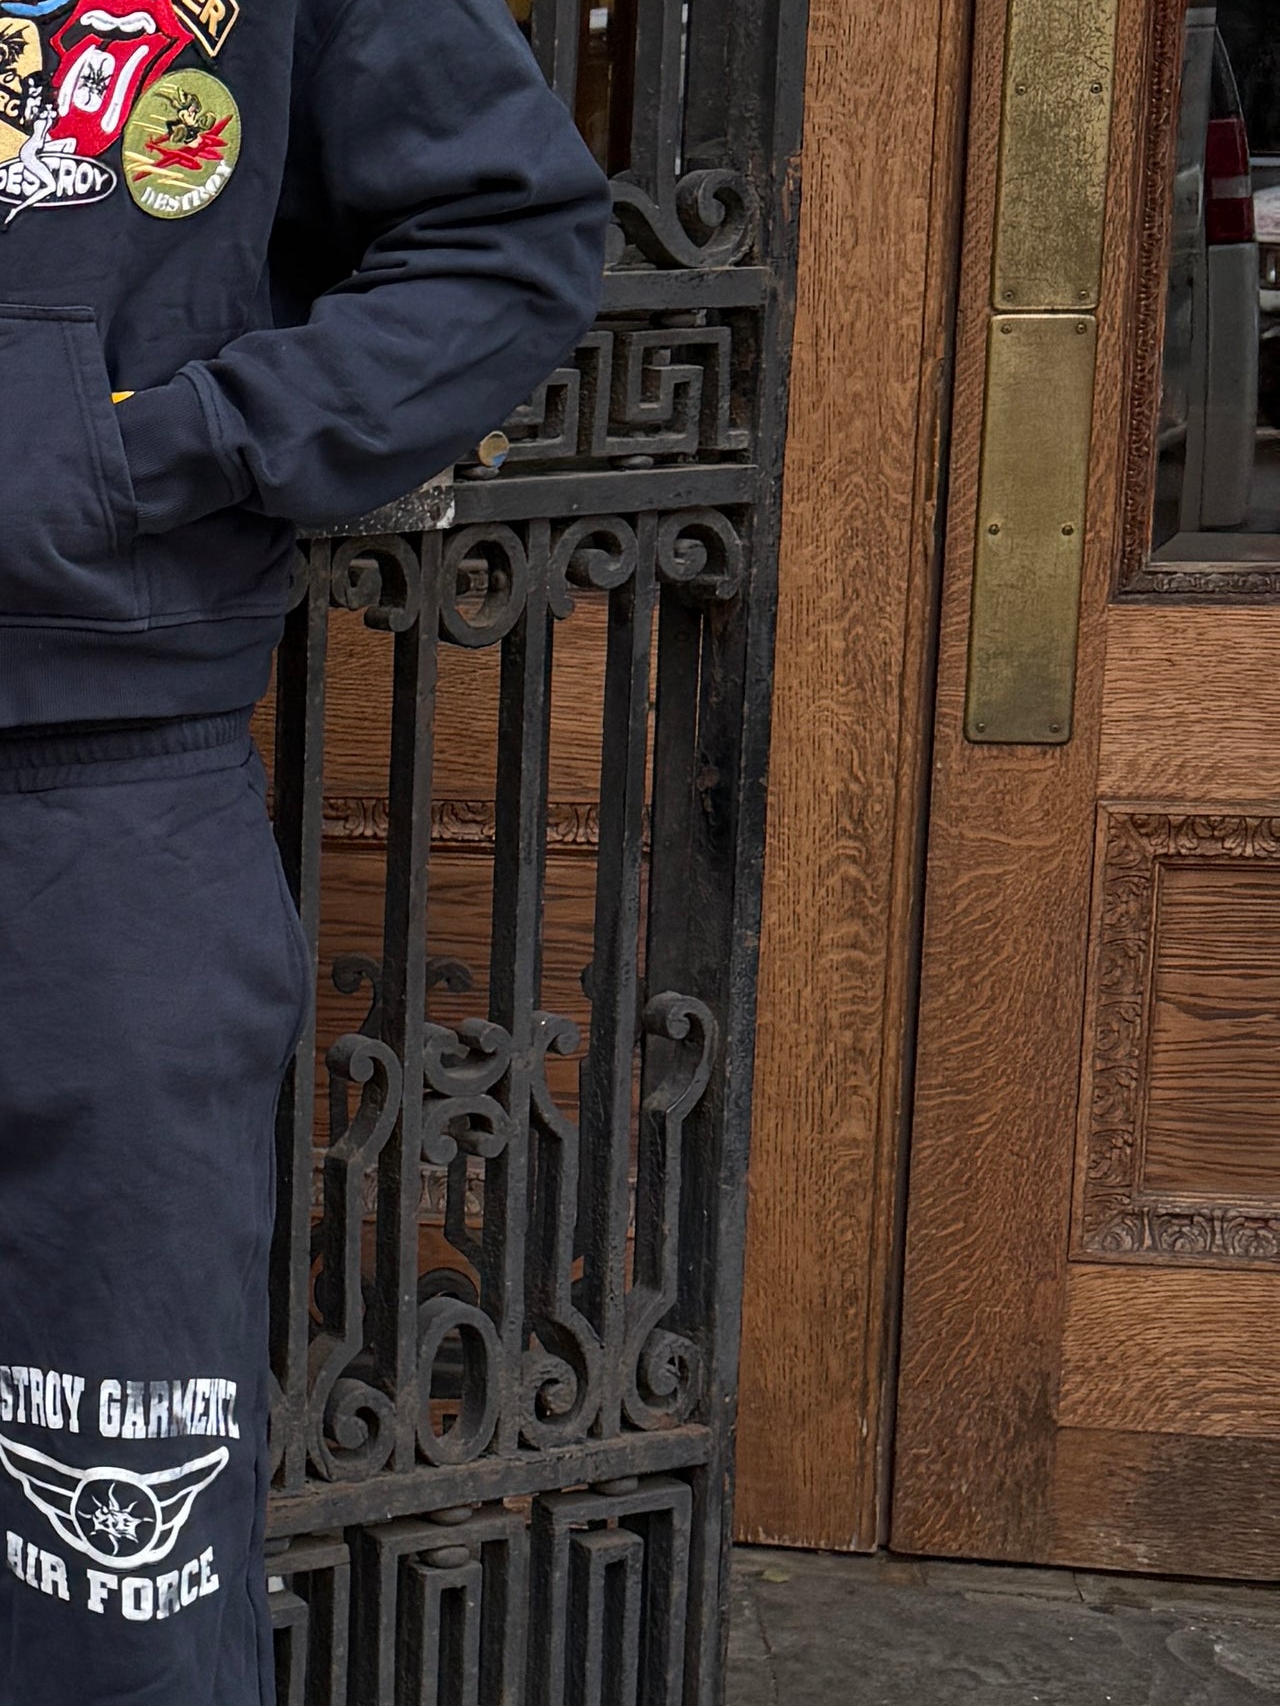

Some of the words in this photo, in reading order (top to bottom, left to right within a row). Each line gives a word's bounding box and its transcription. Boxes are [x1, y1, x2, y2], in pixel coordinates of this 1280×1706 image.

[141, 159, 234, 213] DESTROY
[5, 1530, 70, 1601] AIR
[86, 1546, 220, 1621] FORCE
